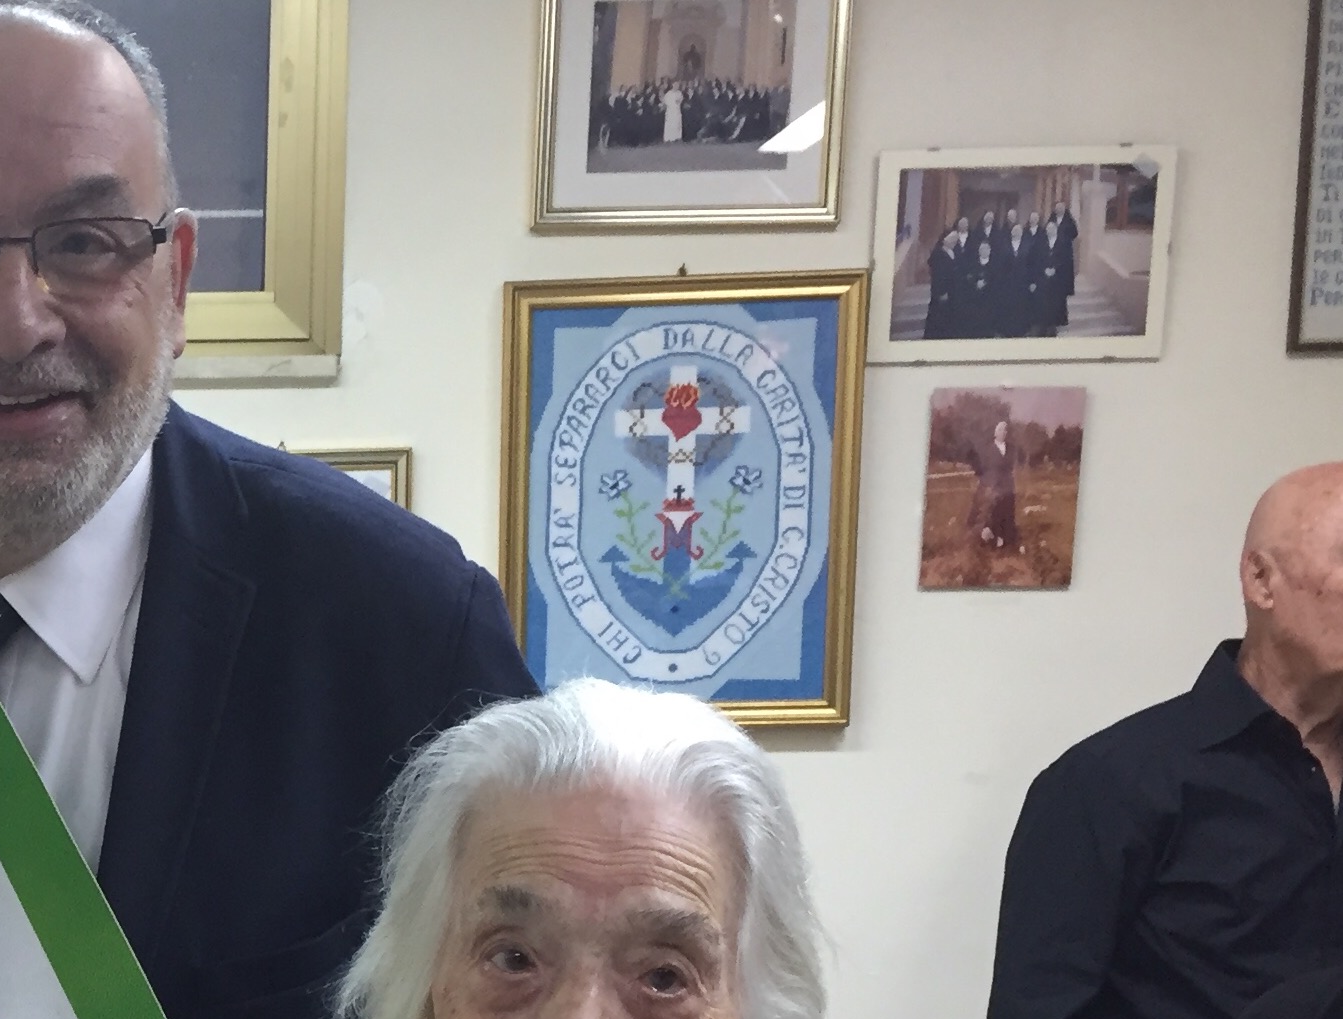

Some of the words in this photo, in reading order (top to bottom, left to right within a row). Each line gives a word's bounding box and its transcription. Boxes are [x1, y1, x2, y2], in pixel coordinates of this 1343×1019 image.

[663, 328, 754, 365] DALLA
[554, 341, 640, 487] SEPARARCI
[782, 485, 805, 510] DI
[598, 621, 642, 664] CHI
